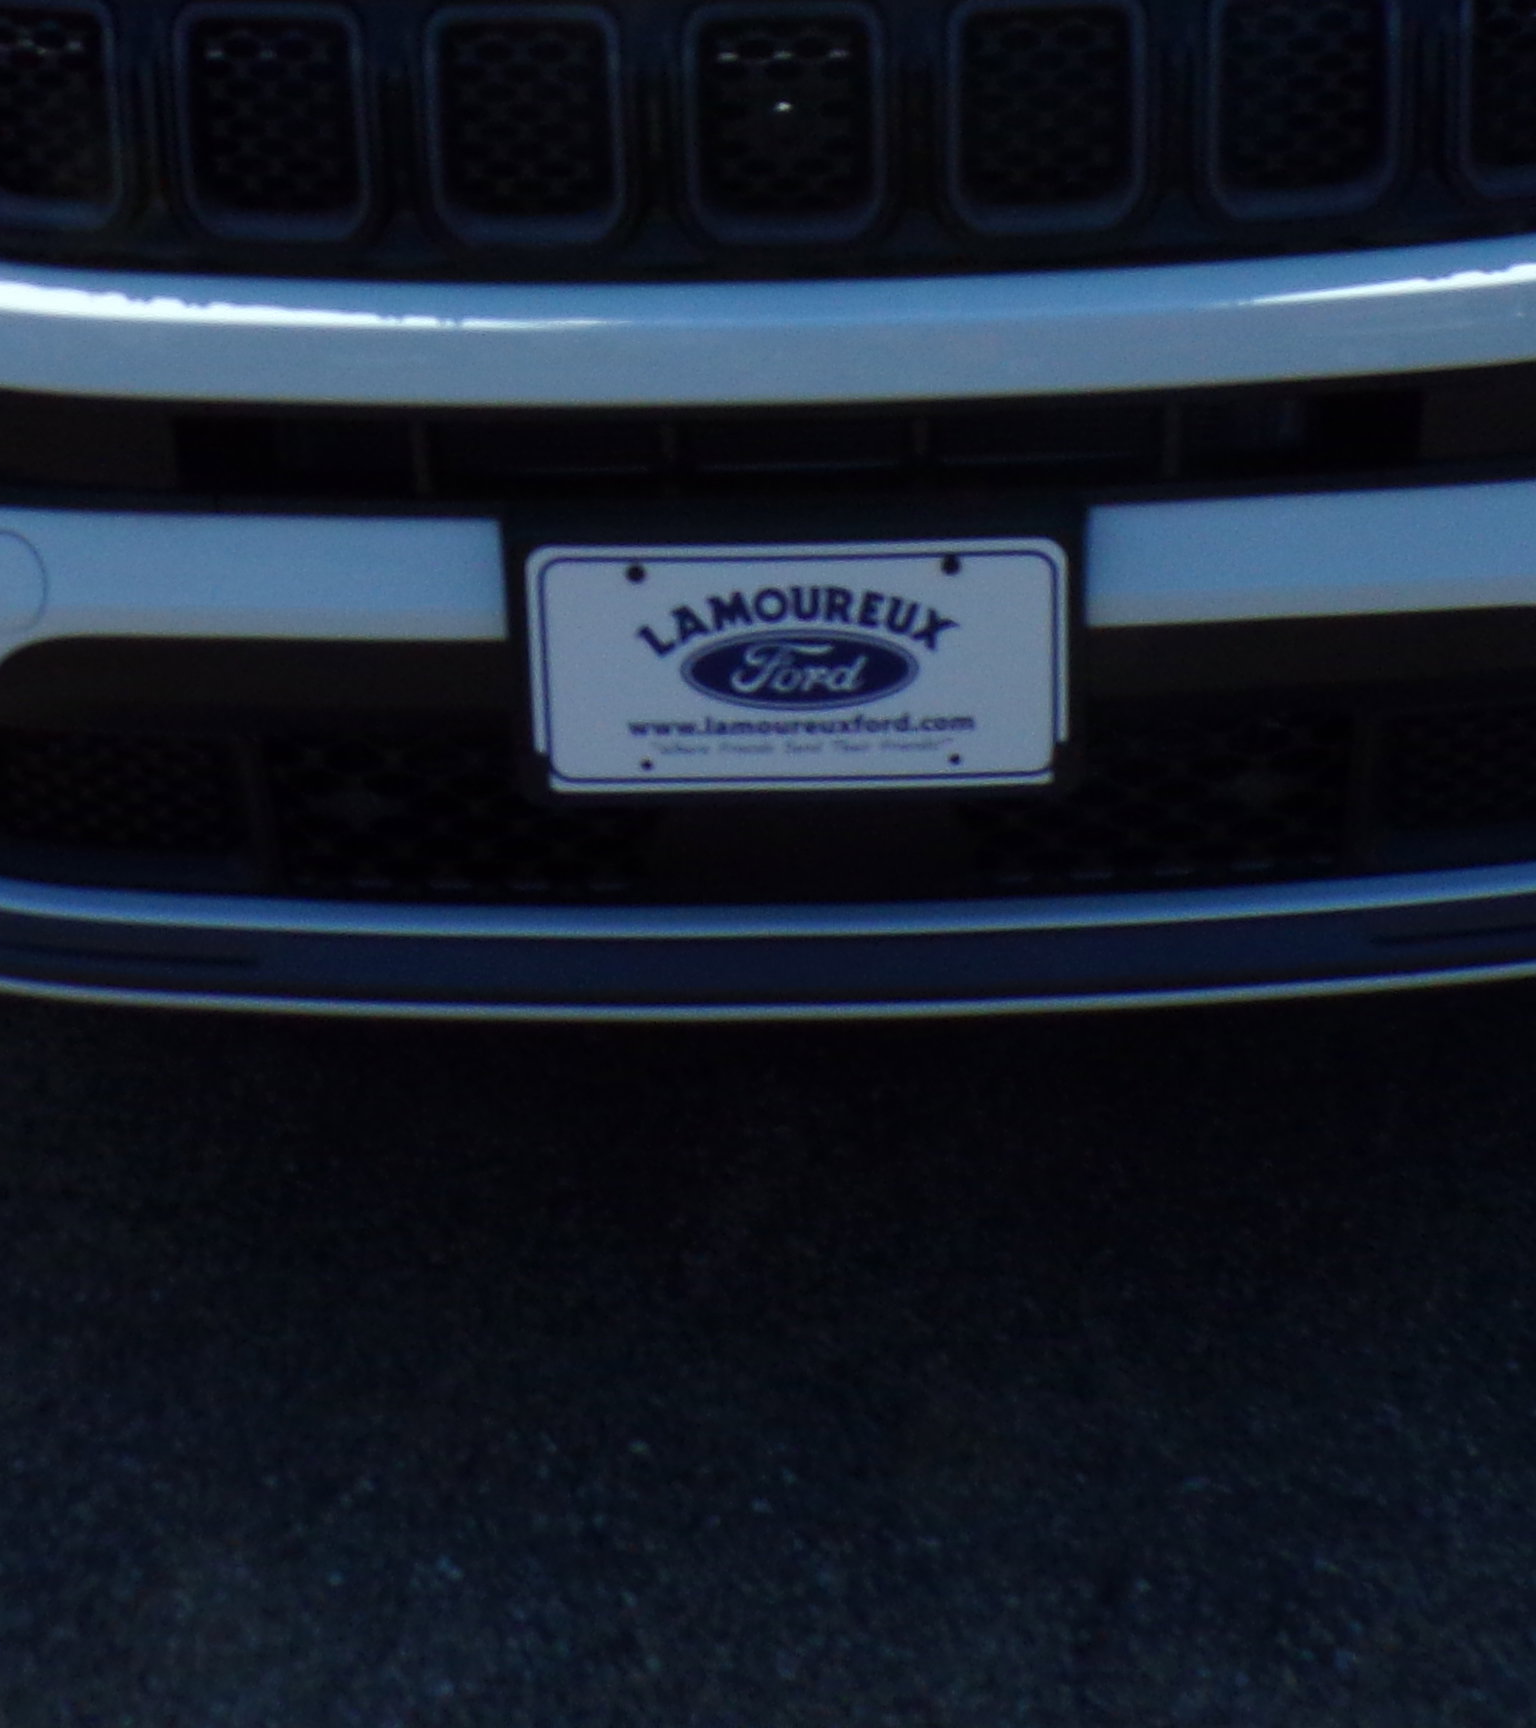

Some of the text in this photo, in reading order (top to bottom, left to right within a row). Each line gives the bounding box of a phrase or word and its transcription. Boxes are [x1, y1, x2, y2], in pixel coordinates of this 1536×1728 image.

[638, 585, 960, 657] LAMOUREUX
[731, 641, 868, 693] Ford
[627, 713, 976, 736] www.lamoureuxford.com
